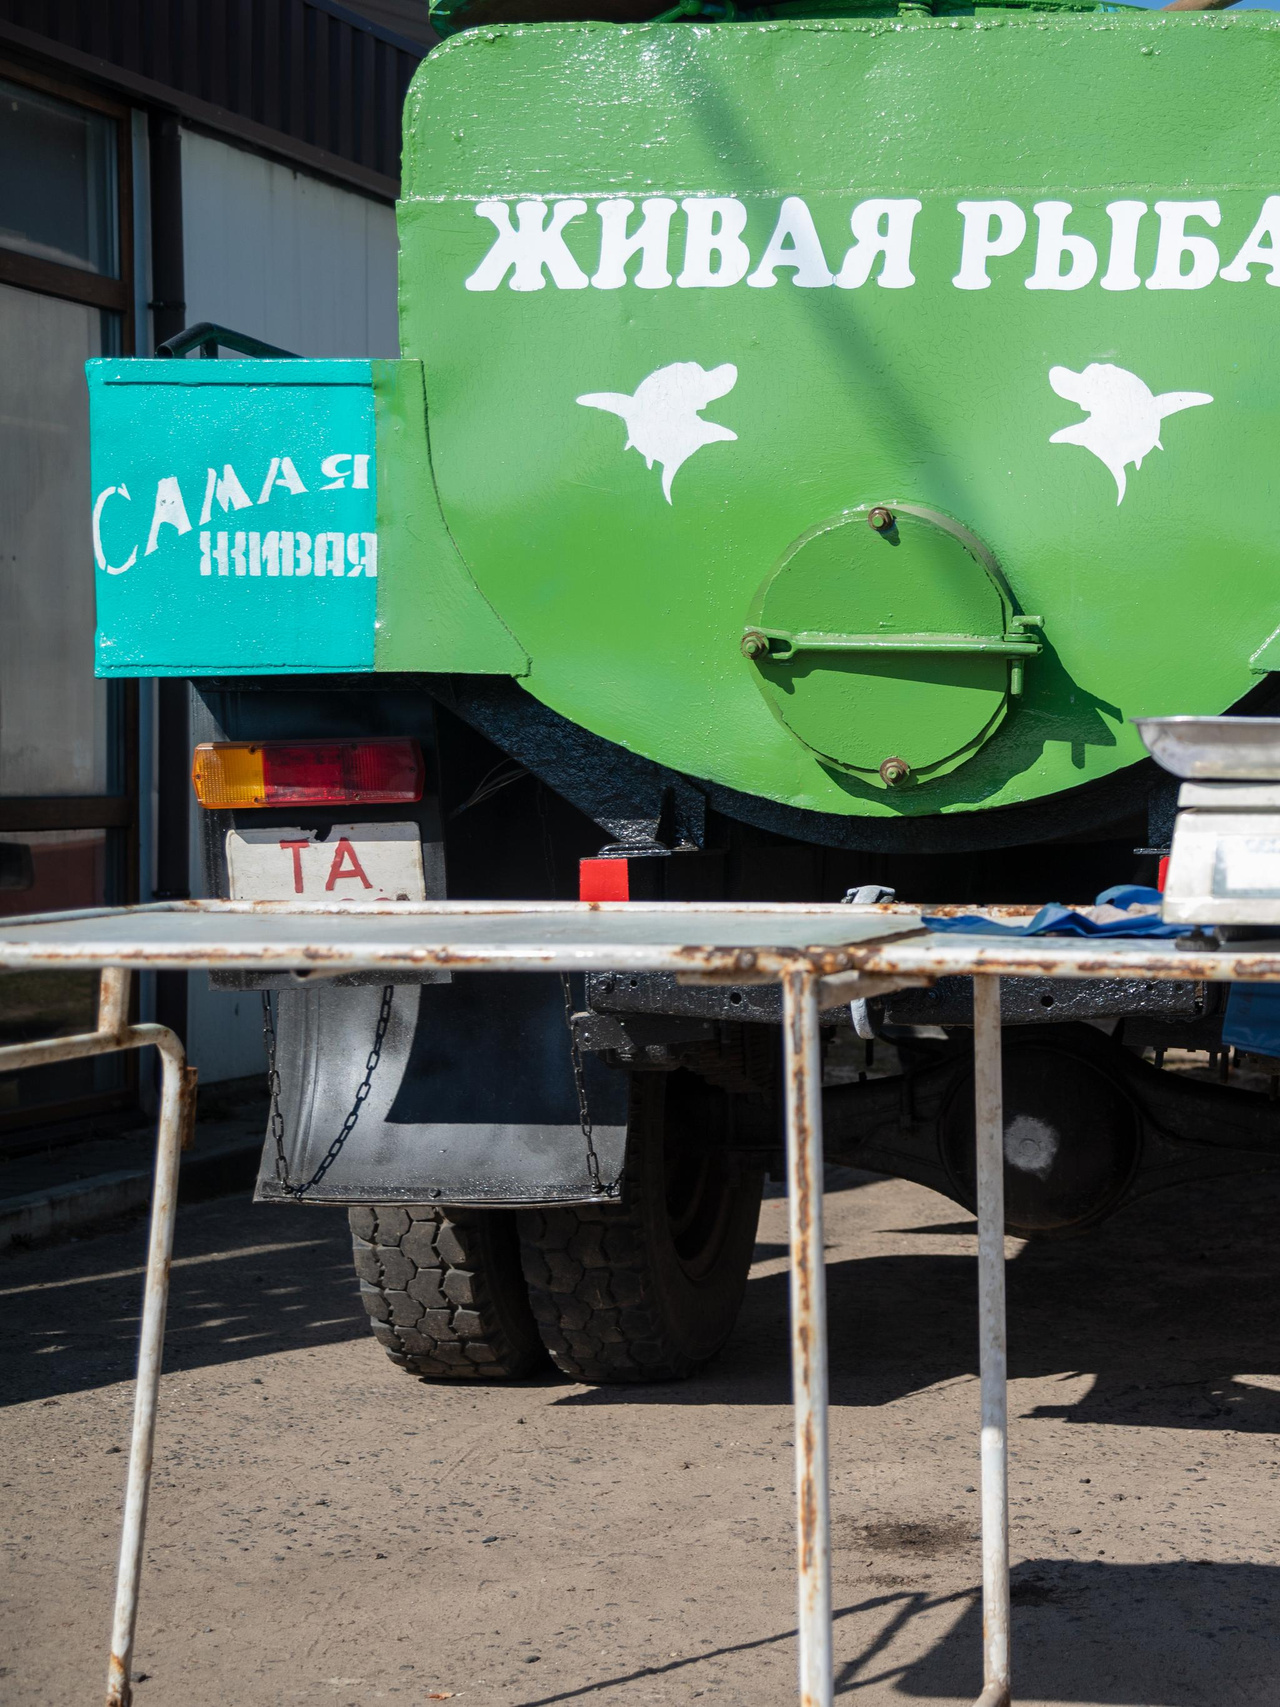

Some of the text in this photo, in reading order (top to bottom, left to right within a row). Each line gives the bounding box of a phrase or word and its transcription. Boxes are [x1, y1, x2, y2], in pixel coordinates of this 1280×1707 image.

[464, 196, 923, 292] ЖИВАЯ
[92, 453, 371, 575] САМАЯ
[199, 530, 378, 577] ЖИВАЯ
